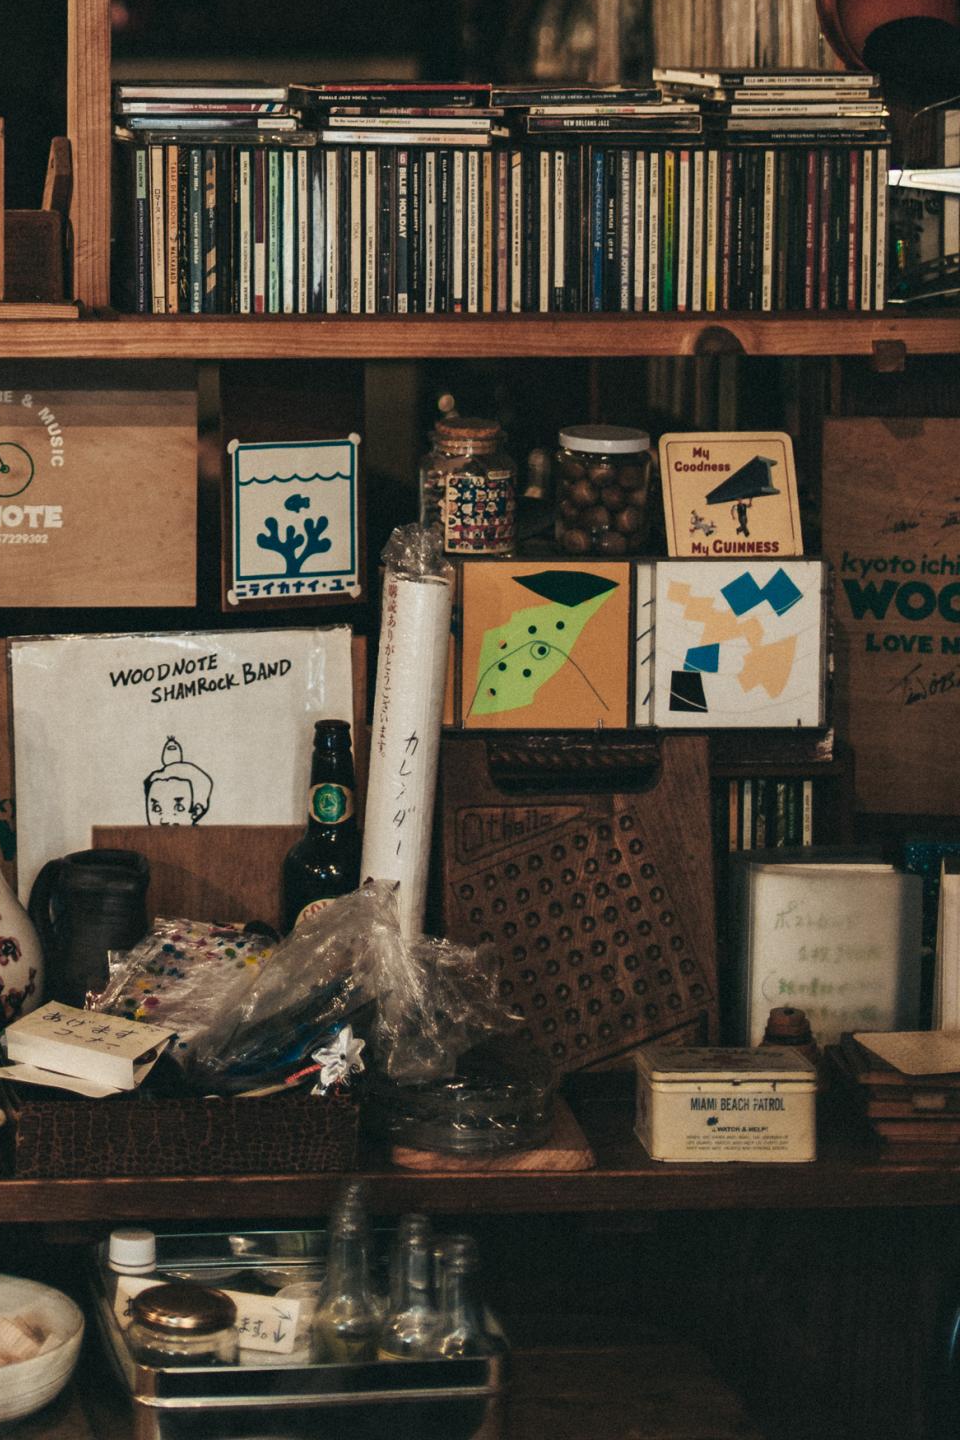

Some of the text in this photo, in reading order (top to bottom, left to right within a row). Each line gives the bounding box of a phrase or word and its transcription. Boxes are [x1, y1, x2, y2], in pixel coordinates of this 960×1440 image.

[399, 167, 408, 238] BILLIE HOLIDAY
[621, 180, 629, 217] AKIYAMA
[621, 225, 629, 248] MAKE
[621, 256, 629, 285] JOYFUL
[621, 286, 629, 310] NOISE
[21, 394, 33, 409] &
[37, 407, 65, 468] MUSIC
[674, 461, 731, 472] Goodness
[692, 447, 710, 460] My
[691, 539, 780, 556] My GUINNESS
[841, 551, 916, 578] kyoto
[866, 633, 933, 653] LOVE
[242, 659, 292, 686] BAND
[393, 730, 419, 855] カレンダー
[42, 1011, 139, 1039] あげます
[690, 1097, 786, 1111] MIAMI BEACH PATROL
